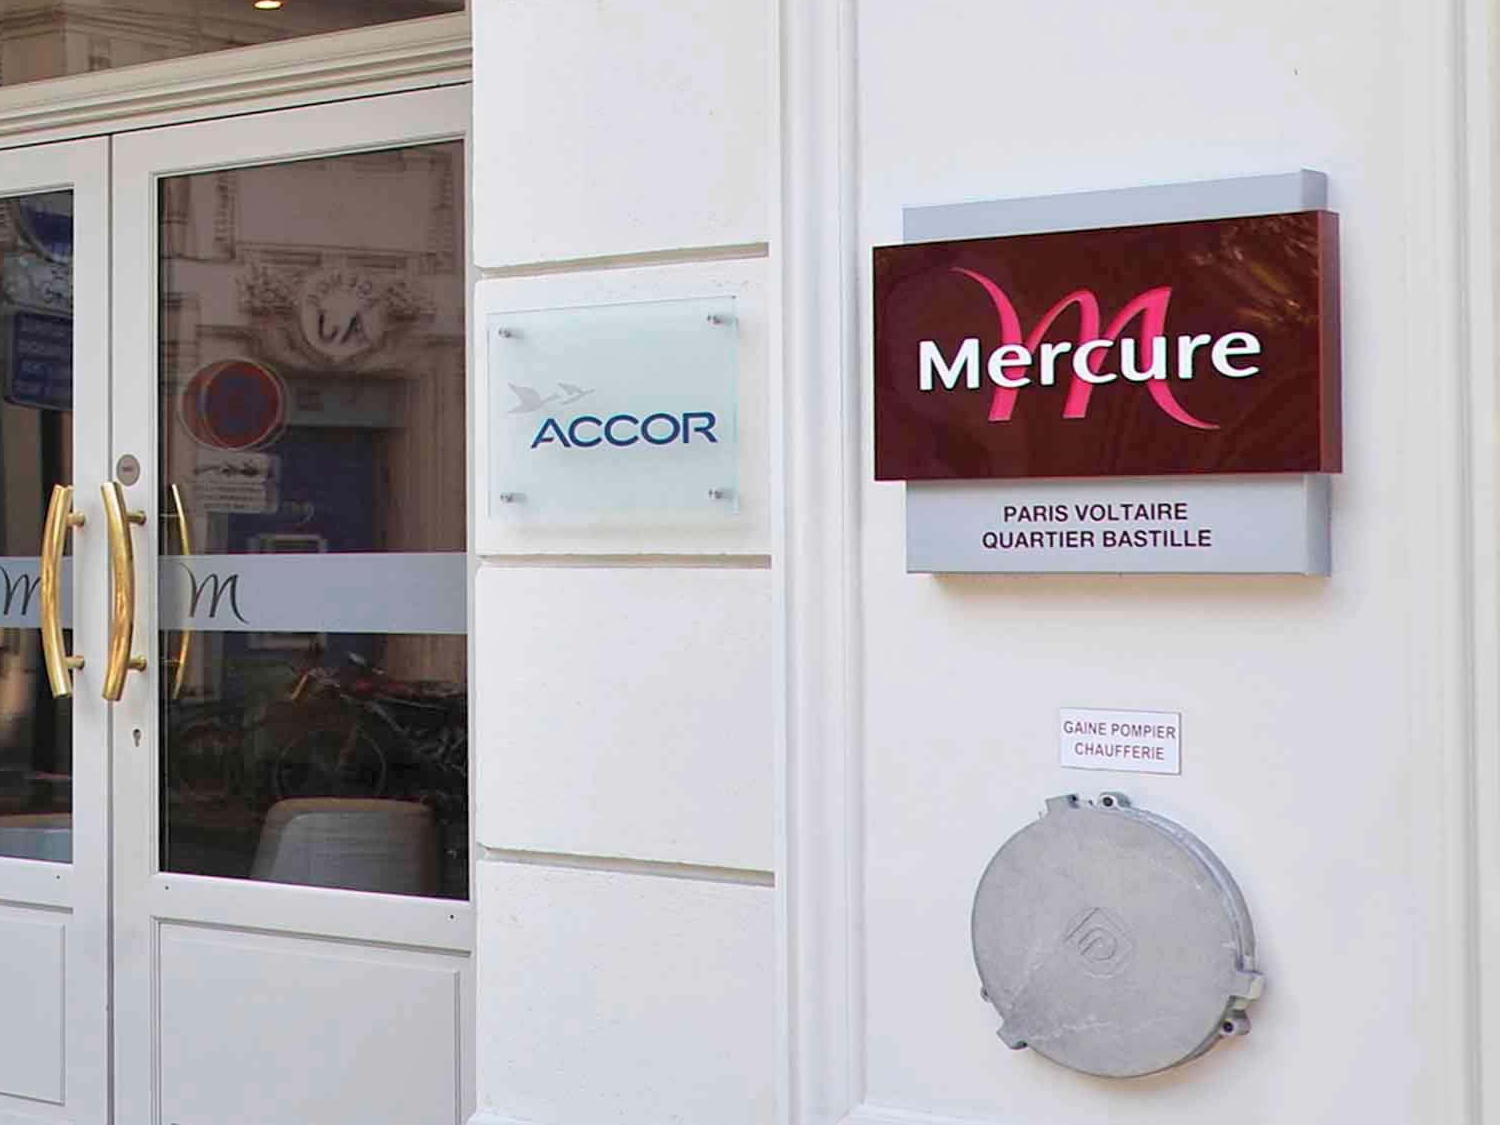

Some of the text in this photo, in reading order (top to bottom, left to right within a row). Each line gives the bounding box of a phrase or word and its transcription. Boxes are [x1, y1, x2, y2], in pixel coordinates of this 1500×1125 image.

[918, 331, 1261, 391] Mercure
[530, 411, 719, 450] ACCOR
[1003, 502, 1189, 523] PARIS VOLTAIRE
[982, 529, 1213, 550] QUARTIER BASTILLE
[1063, 720, 1177, 740] GAINE POMPIER
[1074, 742, 1165, 761] CHAUFFERIE
